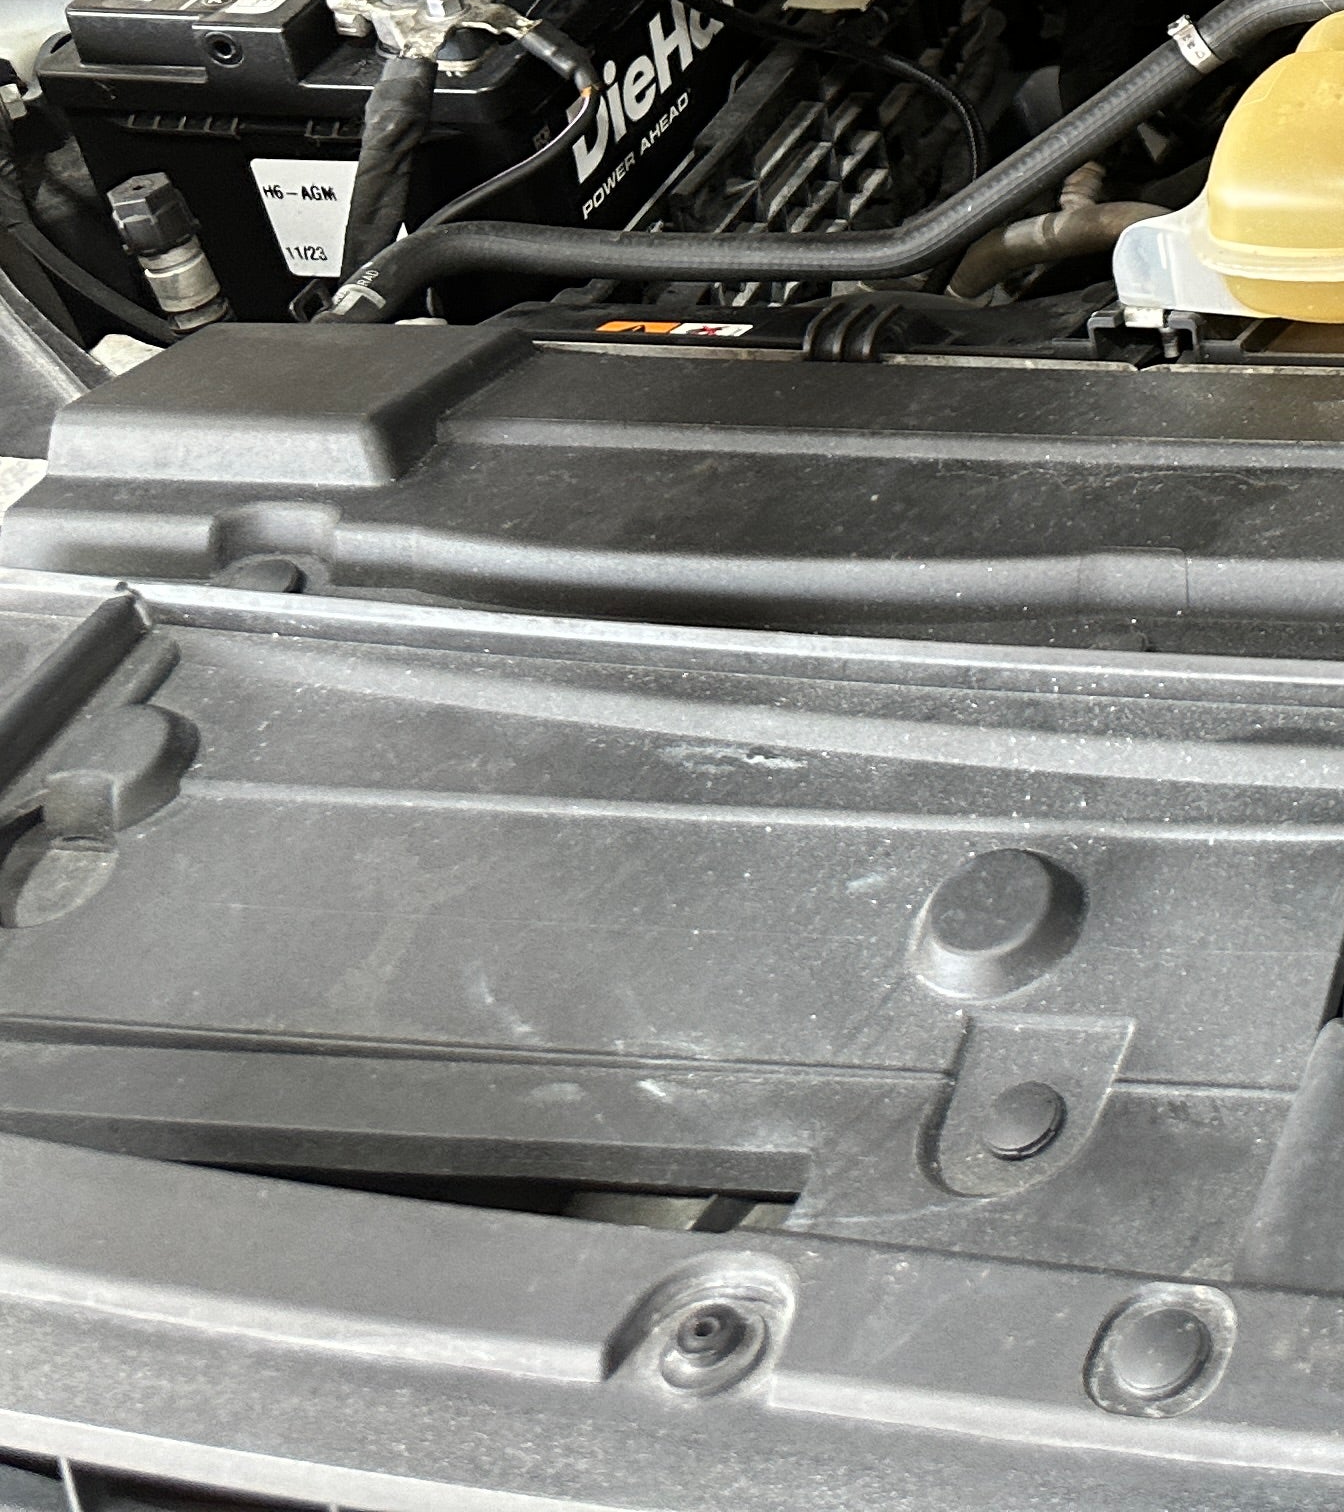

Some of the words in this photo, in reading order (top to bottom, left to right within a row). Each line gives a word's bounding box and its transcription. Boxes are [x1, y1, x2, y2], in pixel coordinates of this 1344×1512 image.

[581, 150, 636, 221] POWER
[639, 90, 690, 157] AHEAD
[262, 184, 338, 202] H6-AGM
[285, 245, 328, 262] 11/23
